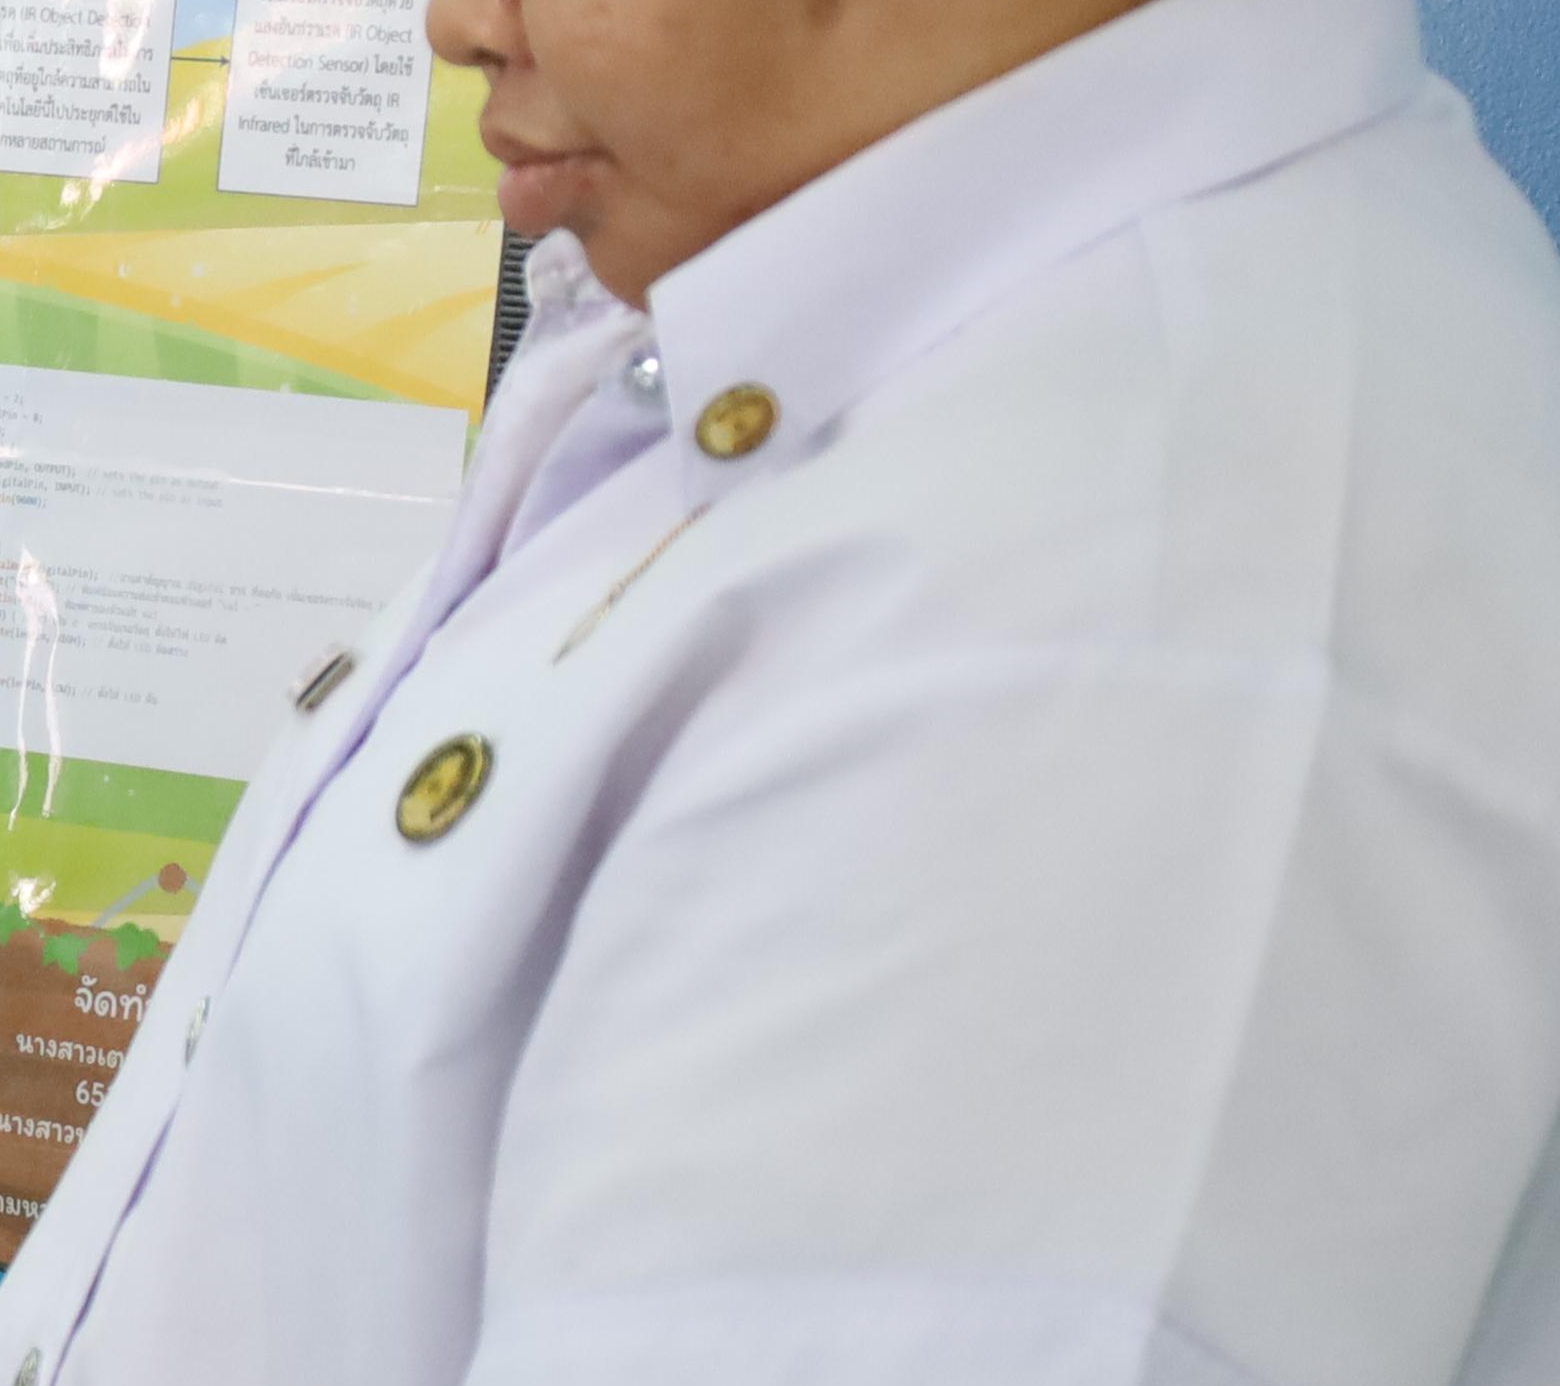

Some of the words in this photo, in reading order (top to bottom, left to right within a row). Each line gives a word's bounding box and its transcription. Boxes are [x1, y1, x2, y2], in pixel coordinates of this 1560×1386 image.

[40, 7, 83, 28] Object
[86, 7, 151, 30] Dection
[366, 24, 413, 45] Object
[248, 51, 313, 70] Detection
[318, 55, 369, 75] Sensor)
[373, 54, 414, 77] โดยใช้
[254, 79, 383, 113] เซ็นเซอร์ตรวจจับวัตถุ
[387, 92, 400, 108] IR
[238, 115, 290, 134] Infrared
[294, 115, 409, 148] ในการตรวจจับวัตถุ
[75, 974, 149, 1023] จัดท
[75, 1080, 109, 1108] 65
